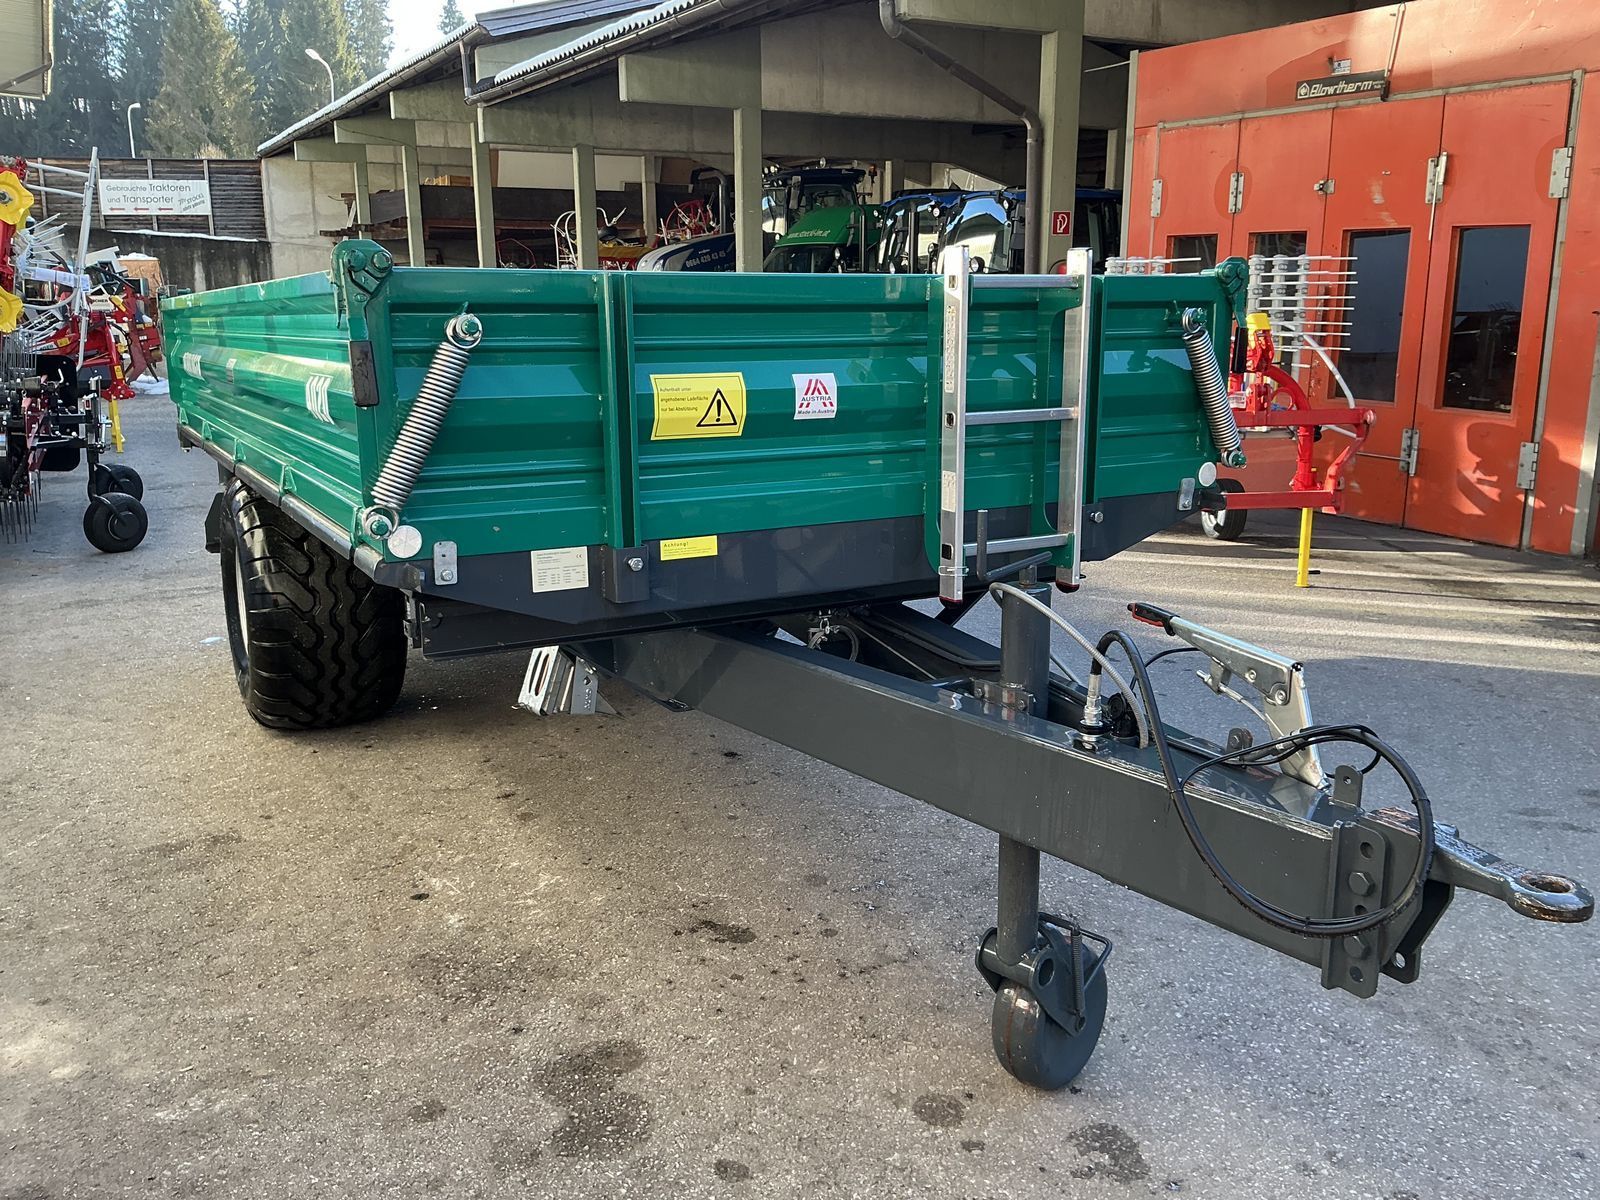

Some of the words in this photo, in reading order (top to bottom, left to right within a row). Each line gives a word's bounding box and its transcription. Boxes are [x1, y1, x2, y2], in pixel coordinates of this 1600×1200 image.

[1309, 80, 1373, 97] Blowtherm
[105, 184, 147, 192] Gebrauchte
[148, 183, 192, 192] Traktoren
[122, 194, 174, 205] Transporter
